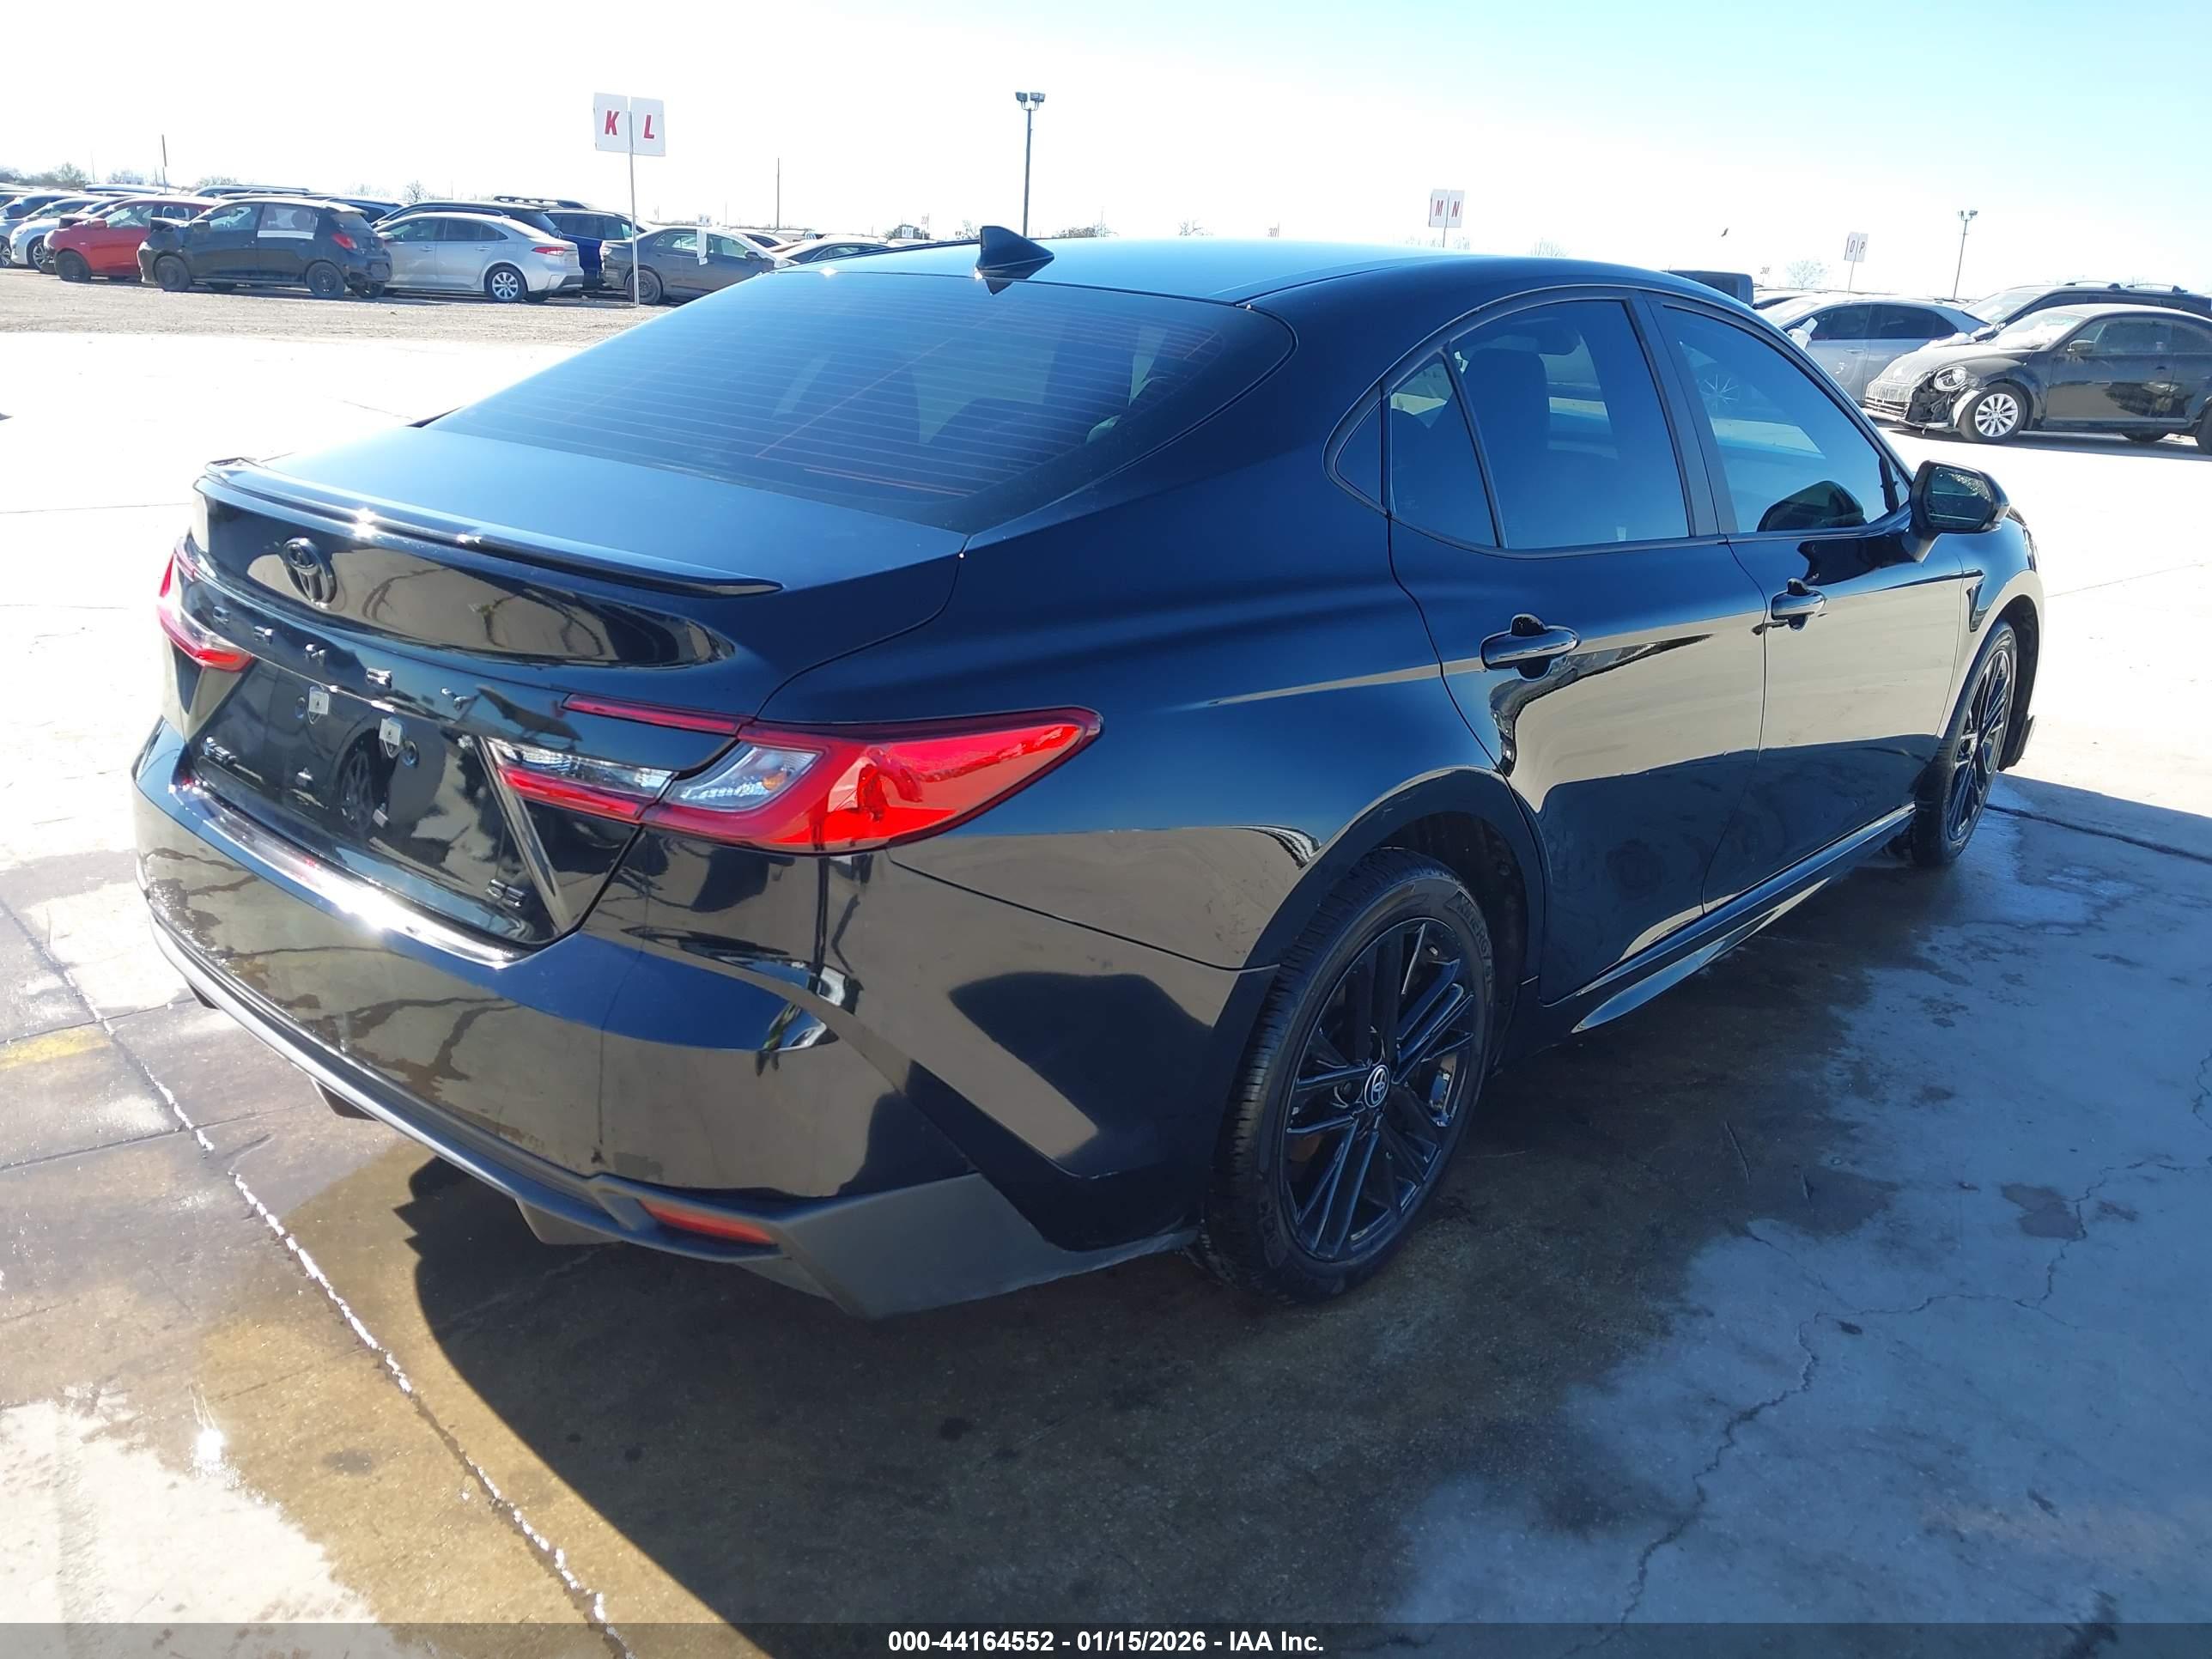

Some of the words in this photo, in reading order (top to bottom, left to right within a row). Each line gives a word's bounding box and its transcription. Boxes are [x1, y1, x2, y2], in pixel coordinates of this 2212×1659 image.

[605, 110, 620, 136] K
[643, 114, 655, 139] L
[1435, 199, 1443, 216] M
[1451, 200, 1461, 217] N
[1858, 240, 1865, 254] P
